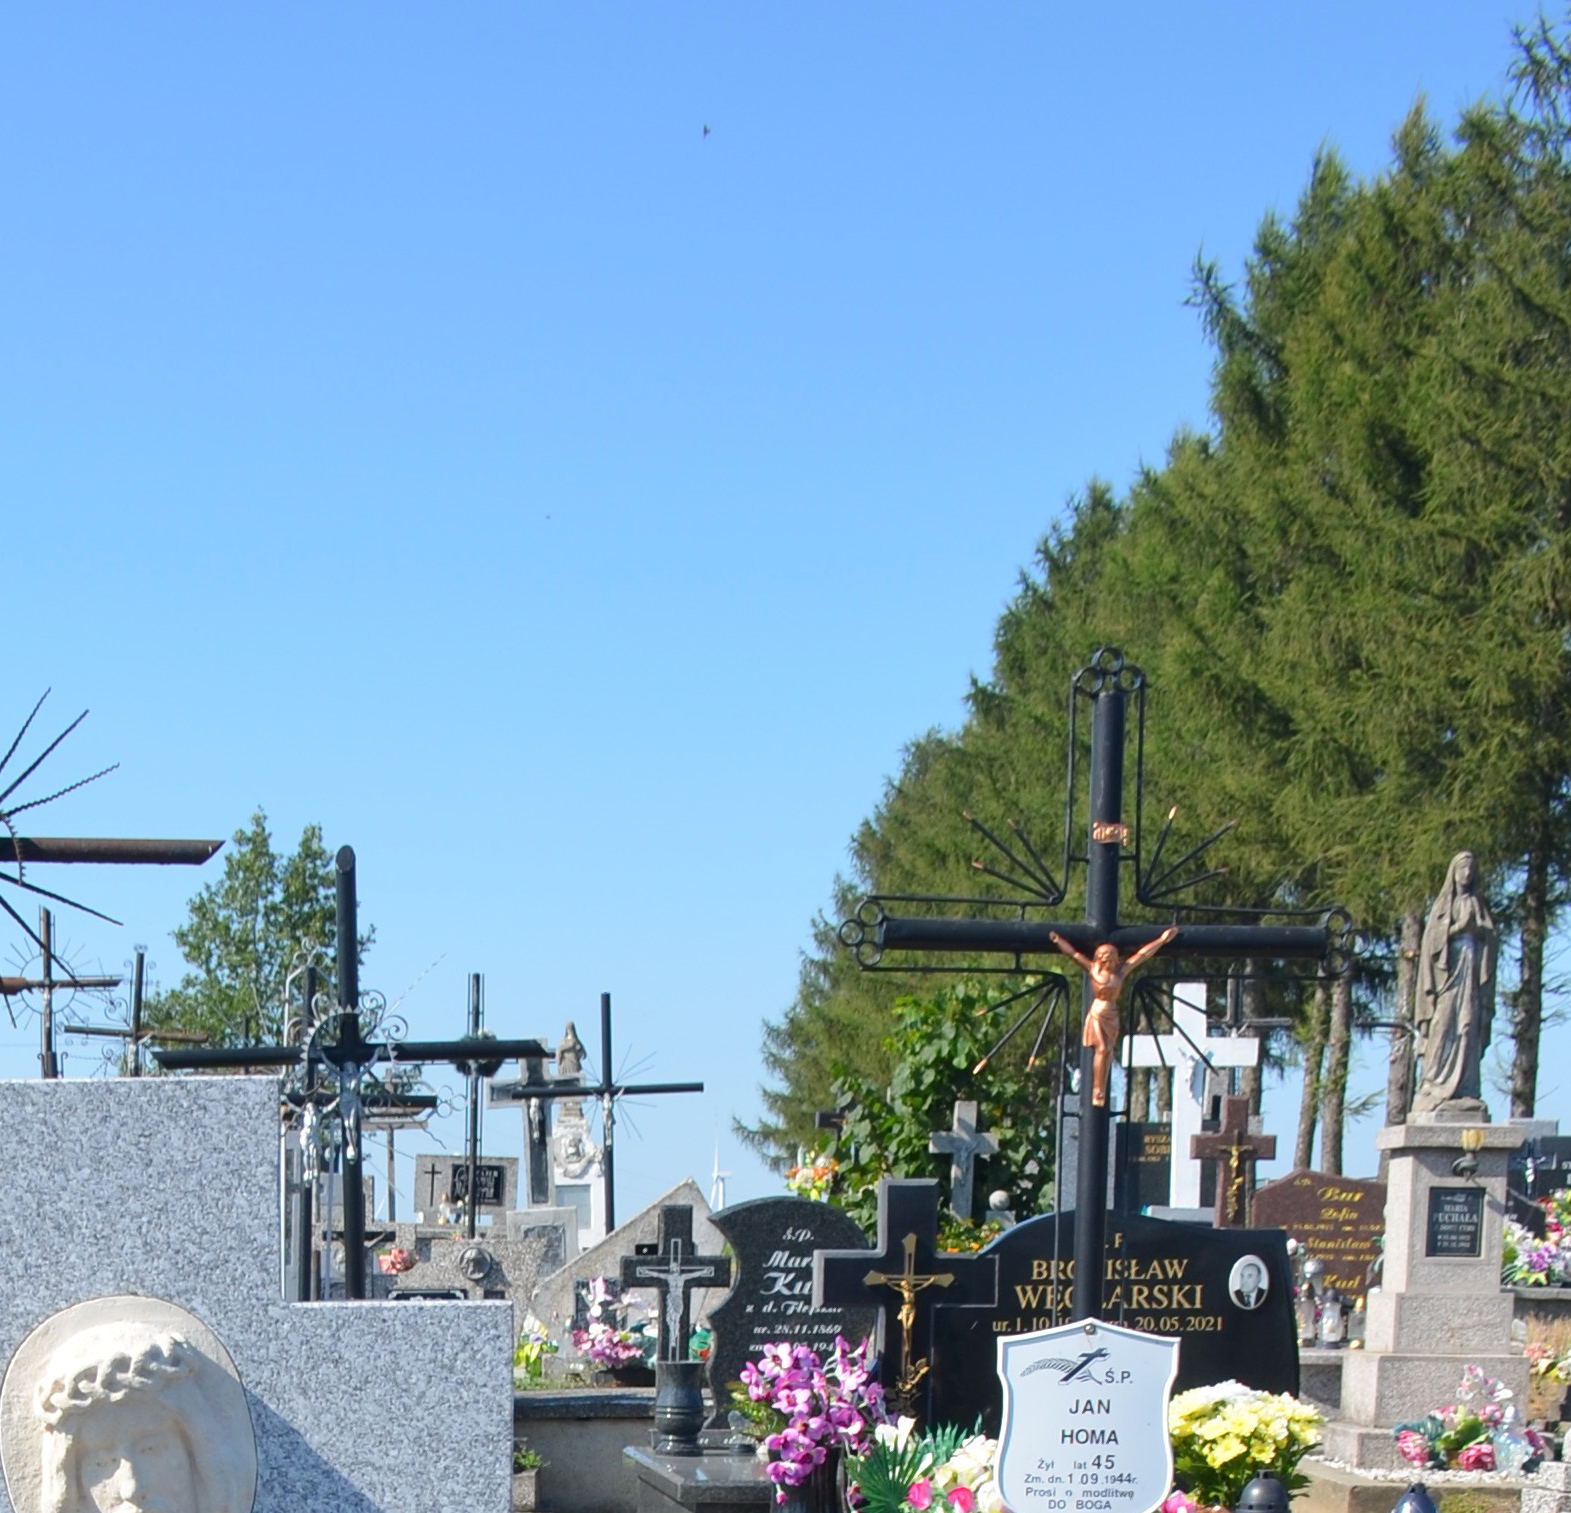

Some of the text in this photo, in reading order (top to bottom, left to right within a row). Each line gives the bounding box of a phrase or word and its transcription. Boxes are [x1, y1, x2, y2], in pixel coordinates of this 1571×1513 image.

[1031, 1258, 1189, 1281] BRISŁAW
[759, 1271, 813, 1296] Ku
[1014, 1284, 1205, 1311] WĘARSKI
[1135, 1315, 1225, 1332] 20.05.2021
[1068, 1399, 1112, 1415] JAN
[1060, 1429, 1120, 1446] HOMA
[1073, 1460, 1087, 1470] lat
[1091, 1454, 1116, 1470] 45
[1025, 1487, 1136, 1500] Prosi o modlitwę
[1047, 1499, 1113, 1511] DO BOGA
